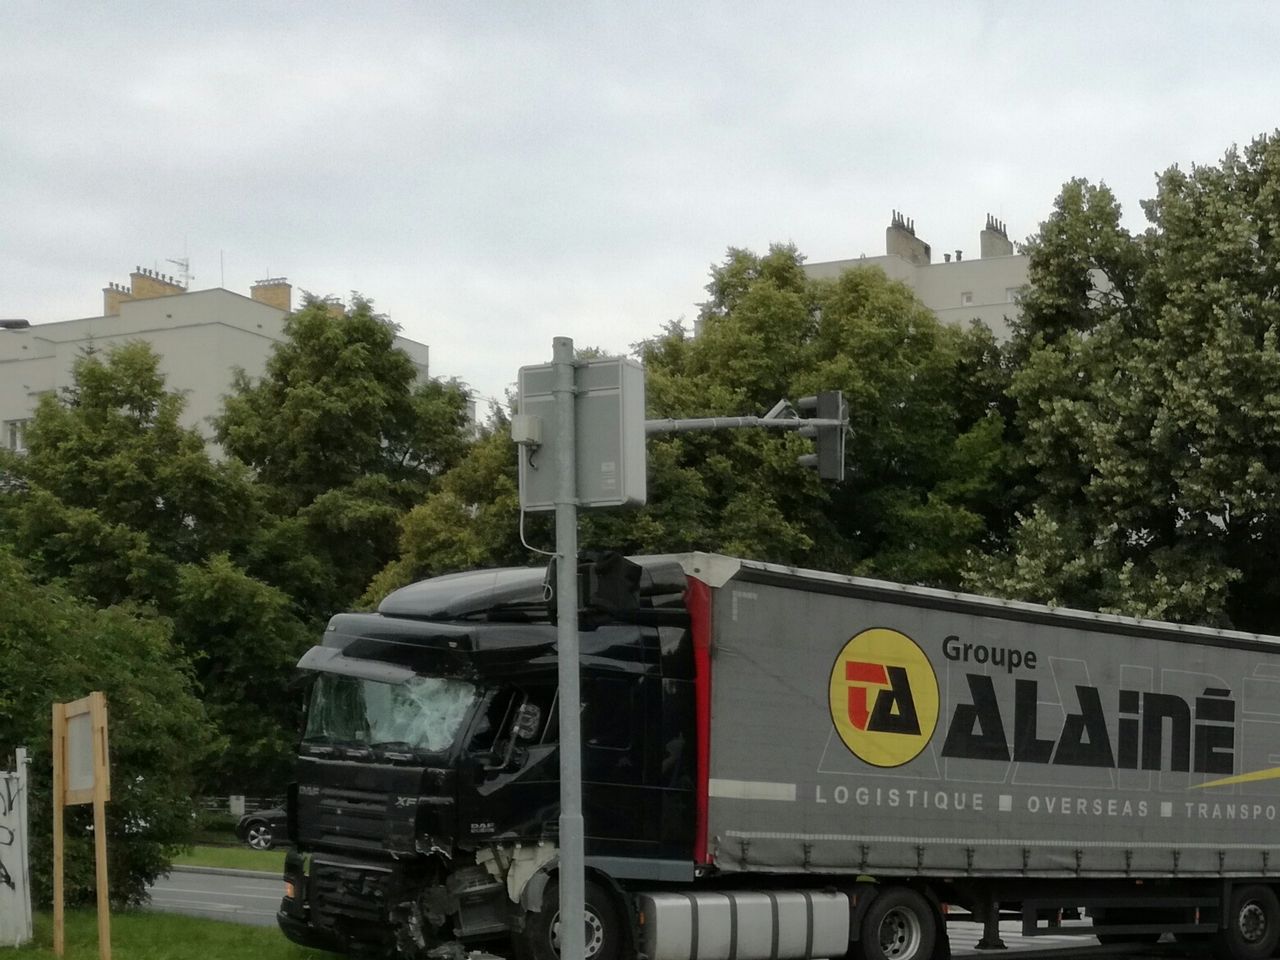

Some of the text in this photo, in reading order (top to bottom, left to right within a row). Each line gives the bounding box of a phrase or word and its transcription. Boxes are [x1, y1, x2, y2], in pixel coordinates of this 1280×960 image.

[942, 634, 1038, 674] Groupe
[815, 785, 983, 811] LOGISTIQUE
[1027, 796, 1148, 816] OVERSEAS
